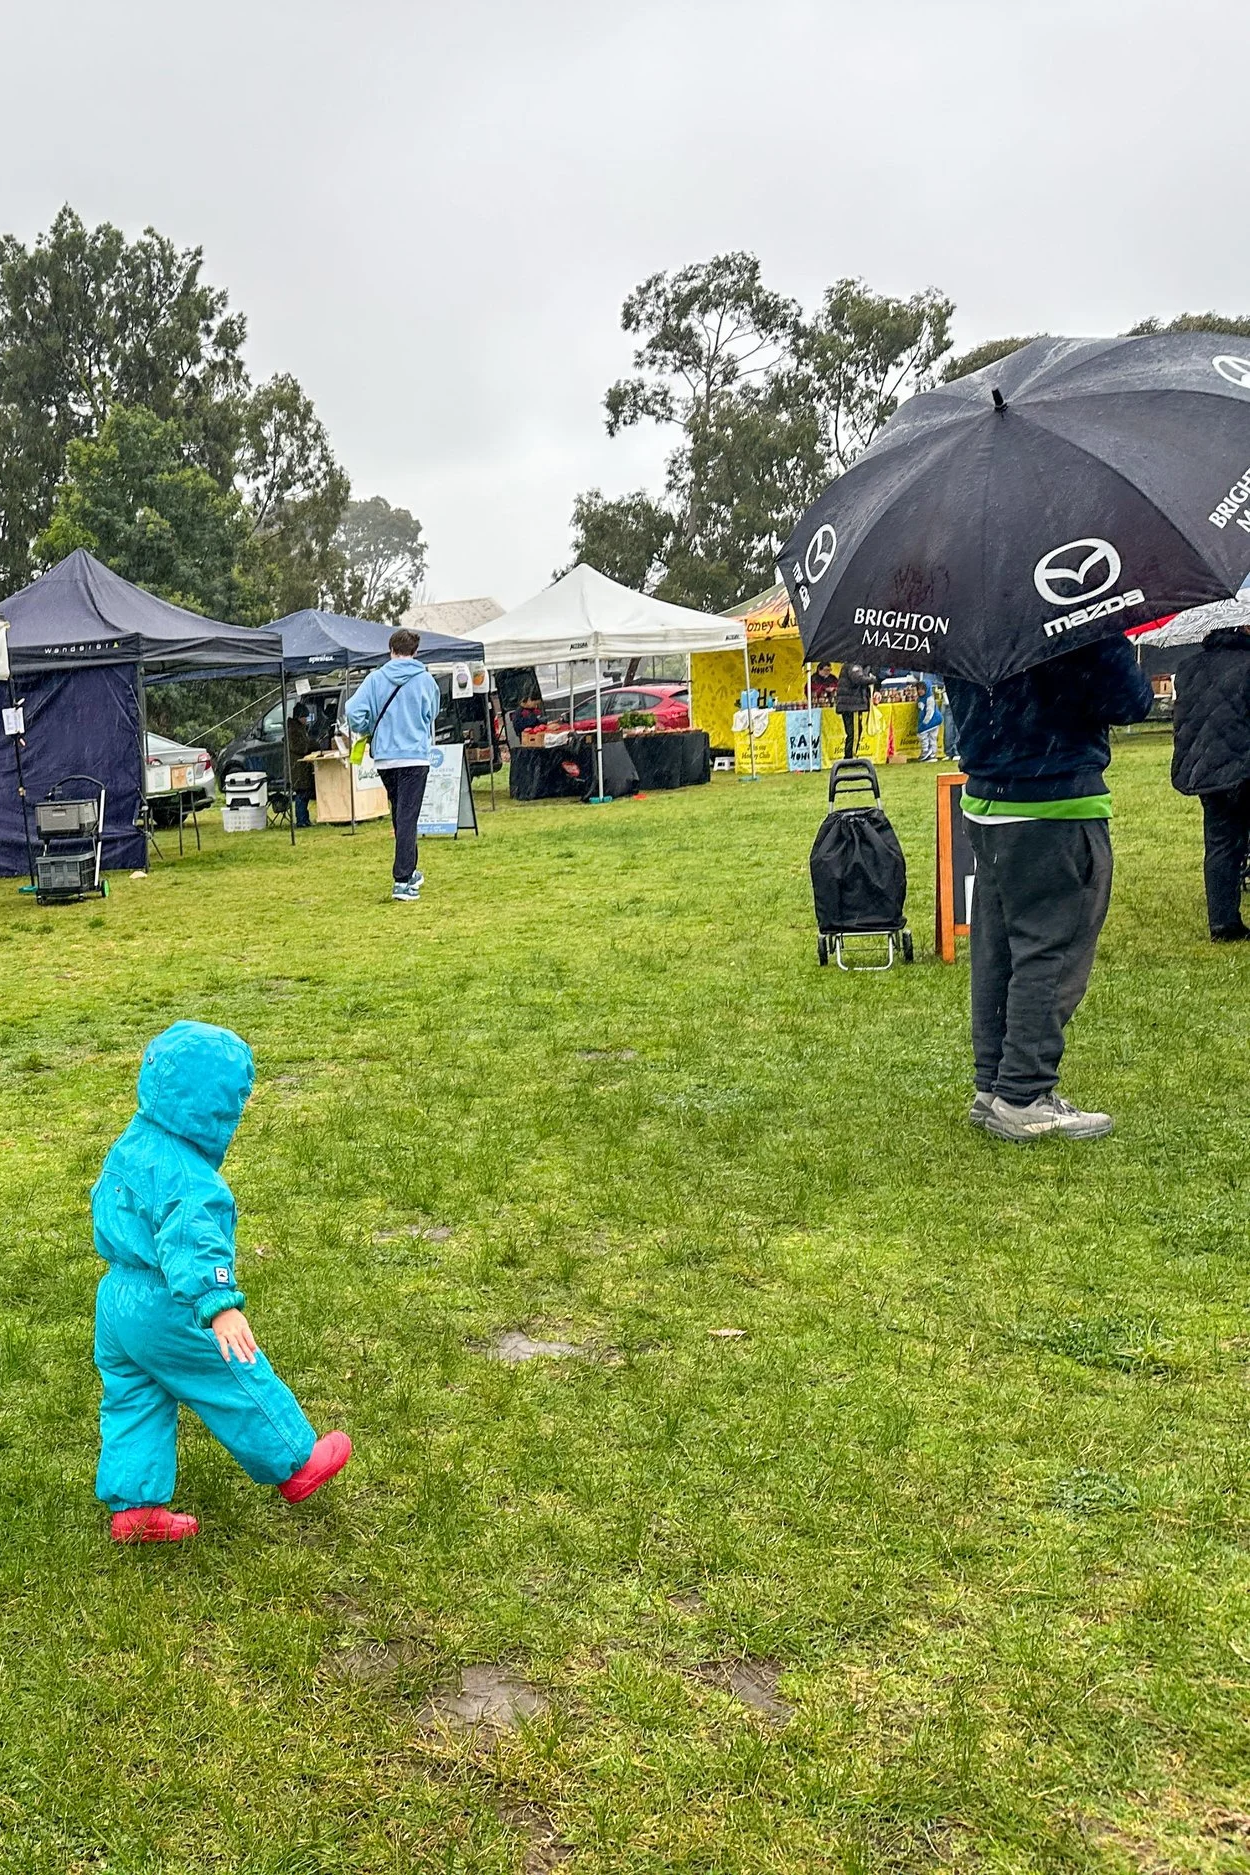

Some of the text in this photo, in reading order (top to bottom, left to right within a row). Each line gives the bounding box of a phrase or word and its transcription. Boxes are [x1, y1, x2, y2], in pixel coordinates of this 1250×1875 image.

[853, 607, 950, 635] BRIGHTON
[861, 628, 932, 654] MAZDA
[750, 652, 775, 666] RAW
[789, 734, 820, 749] RAW
